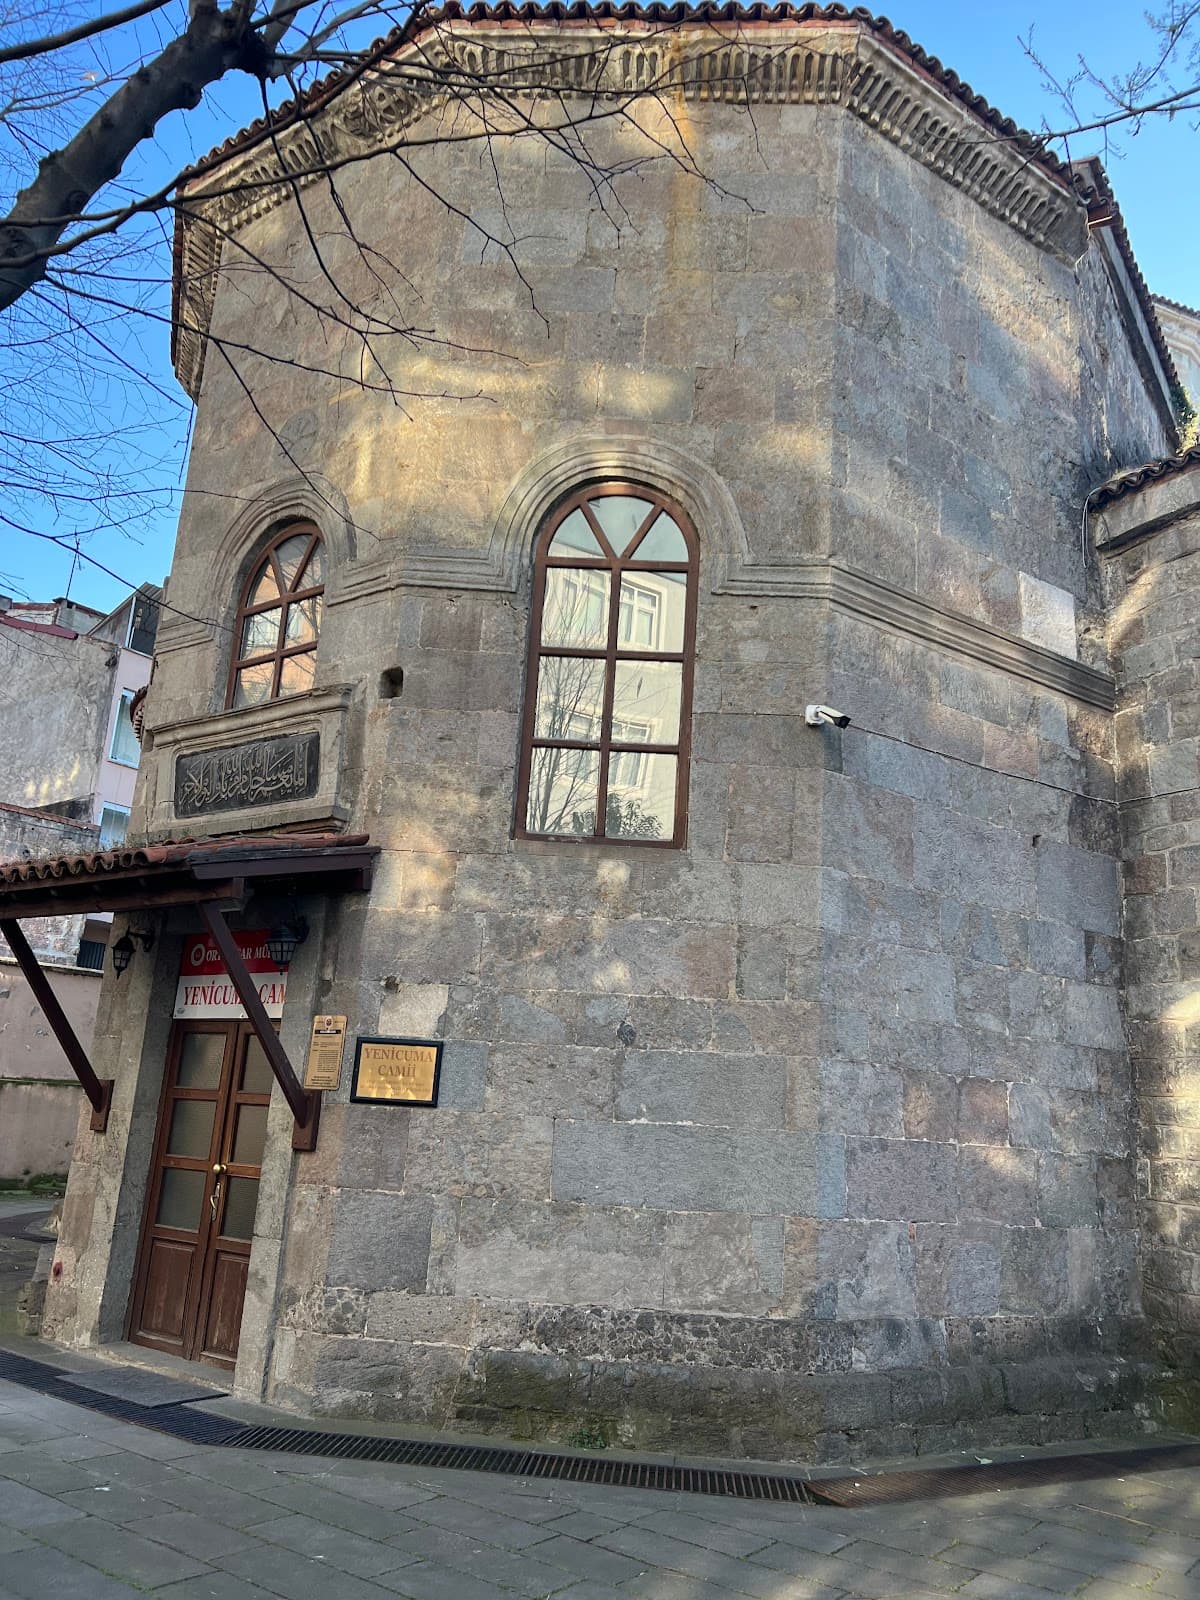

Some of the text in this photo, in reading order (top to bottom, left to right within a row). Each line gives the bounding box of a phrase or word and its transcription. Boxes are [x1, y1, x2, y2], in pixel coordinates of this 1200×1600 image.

[184, 979, 242, 1005] YENİCUM
[365, 1047, 433, 1063] YENİCUMA
[378, 1063, 416, 1078] CAMİİ
